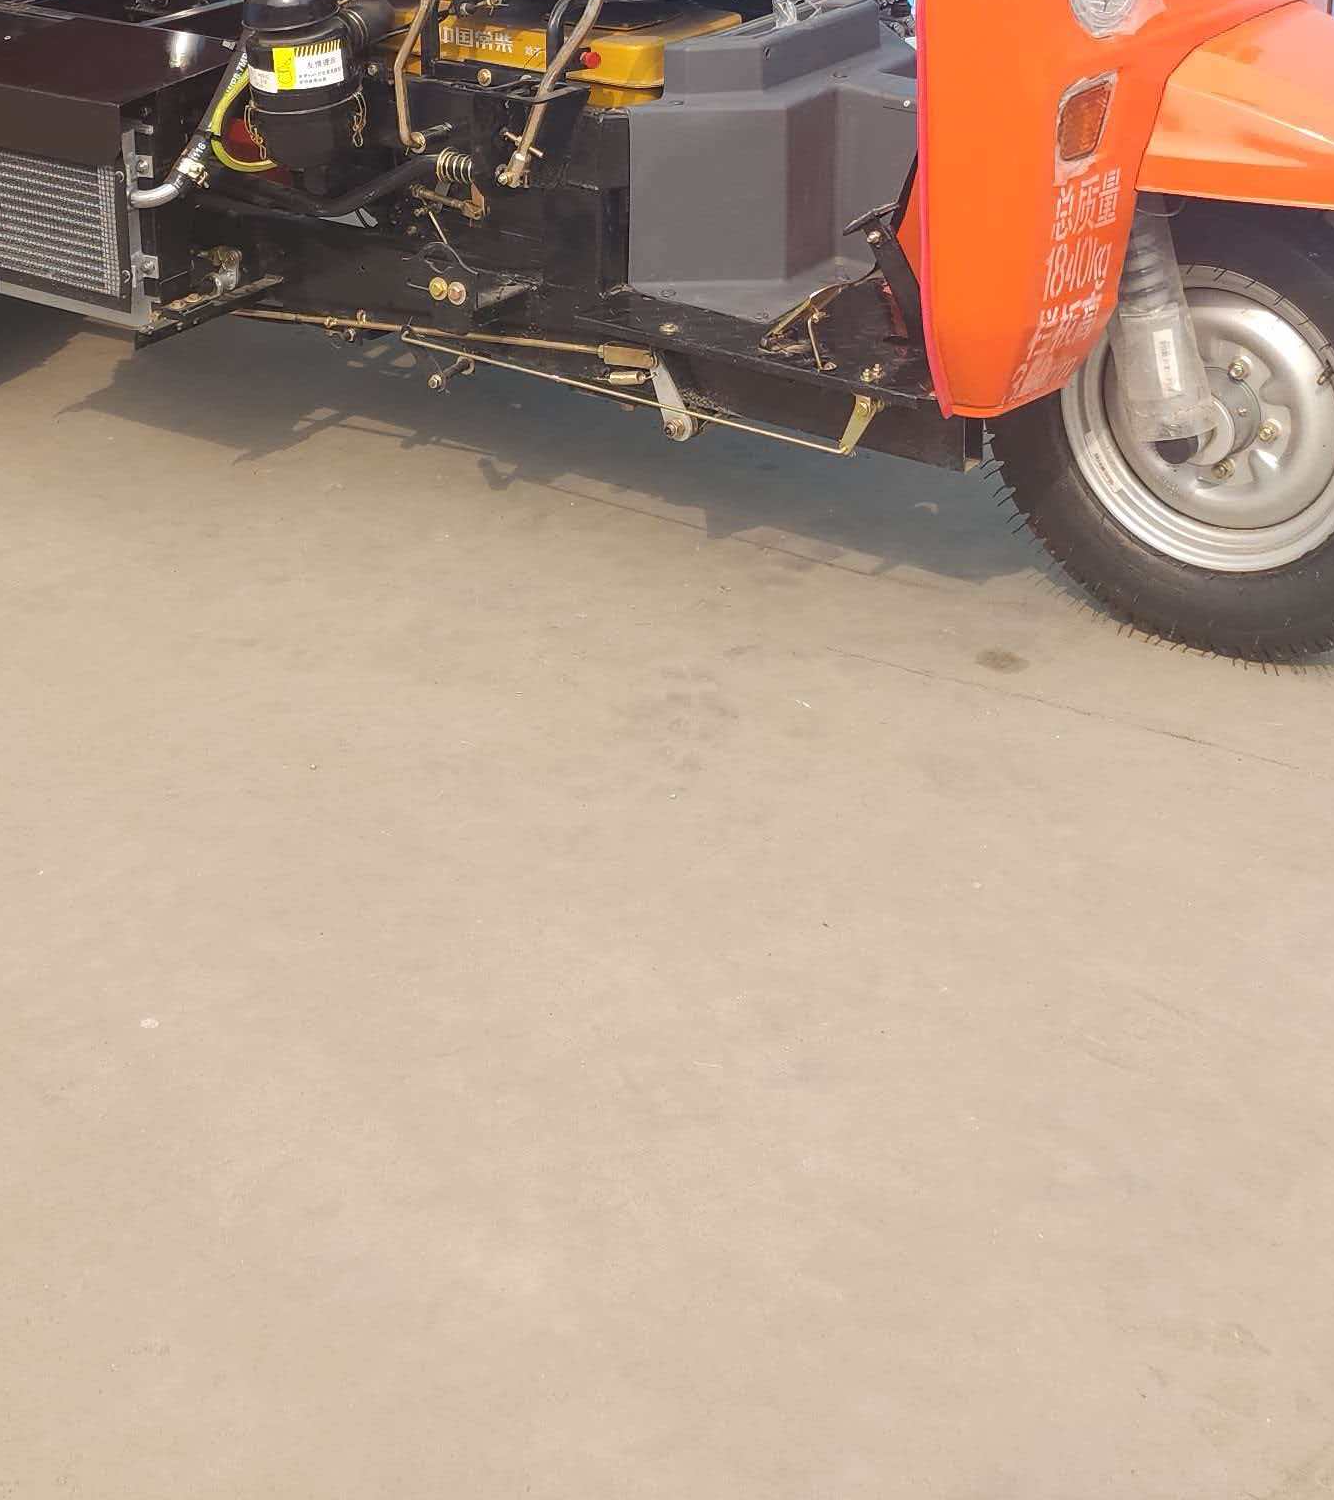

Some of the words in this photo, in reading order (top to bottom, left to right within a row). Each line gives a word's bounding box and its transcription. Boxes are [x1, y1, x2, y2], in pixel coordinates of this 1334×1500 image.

[1051, 167, 1121, 241] 总质量
[1043, 235, 1112, 302] 1840kg
